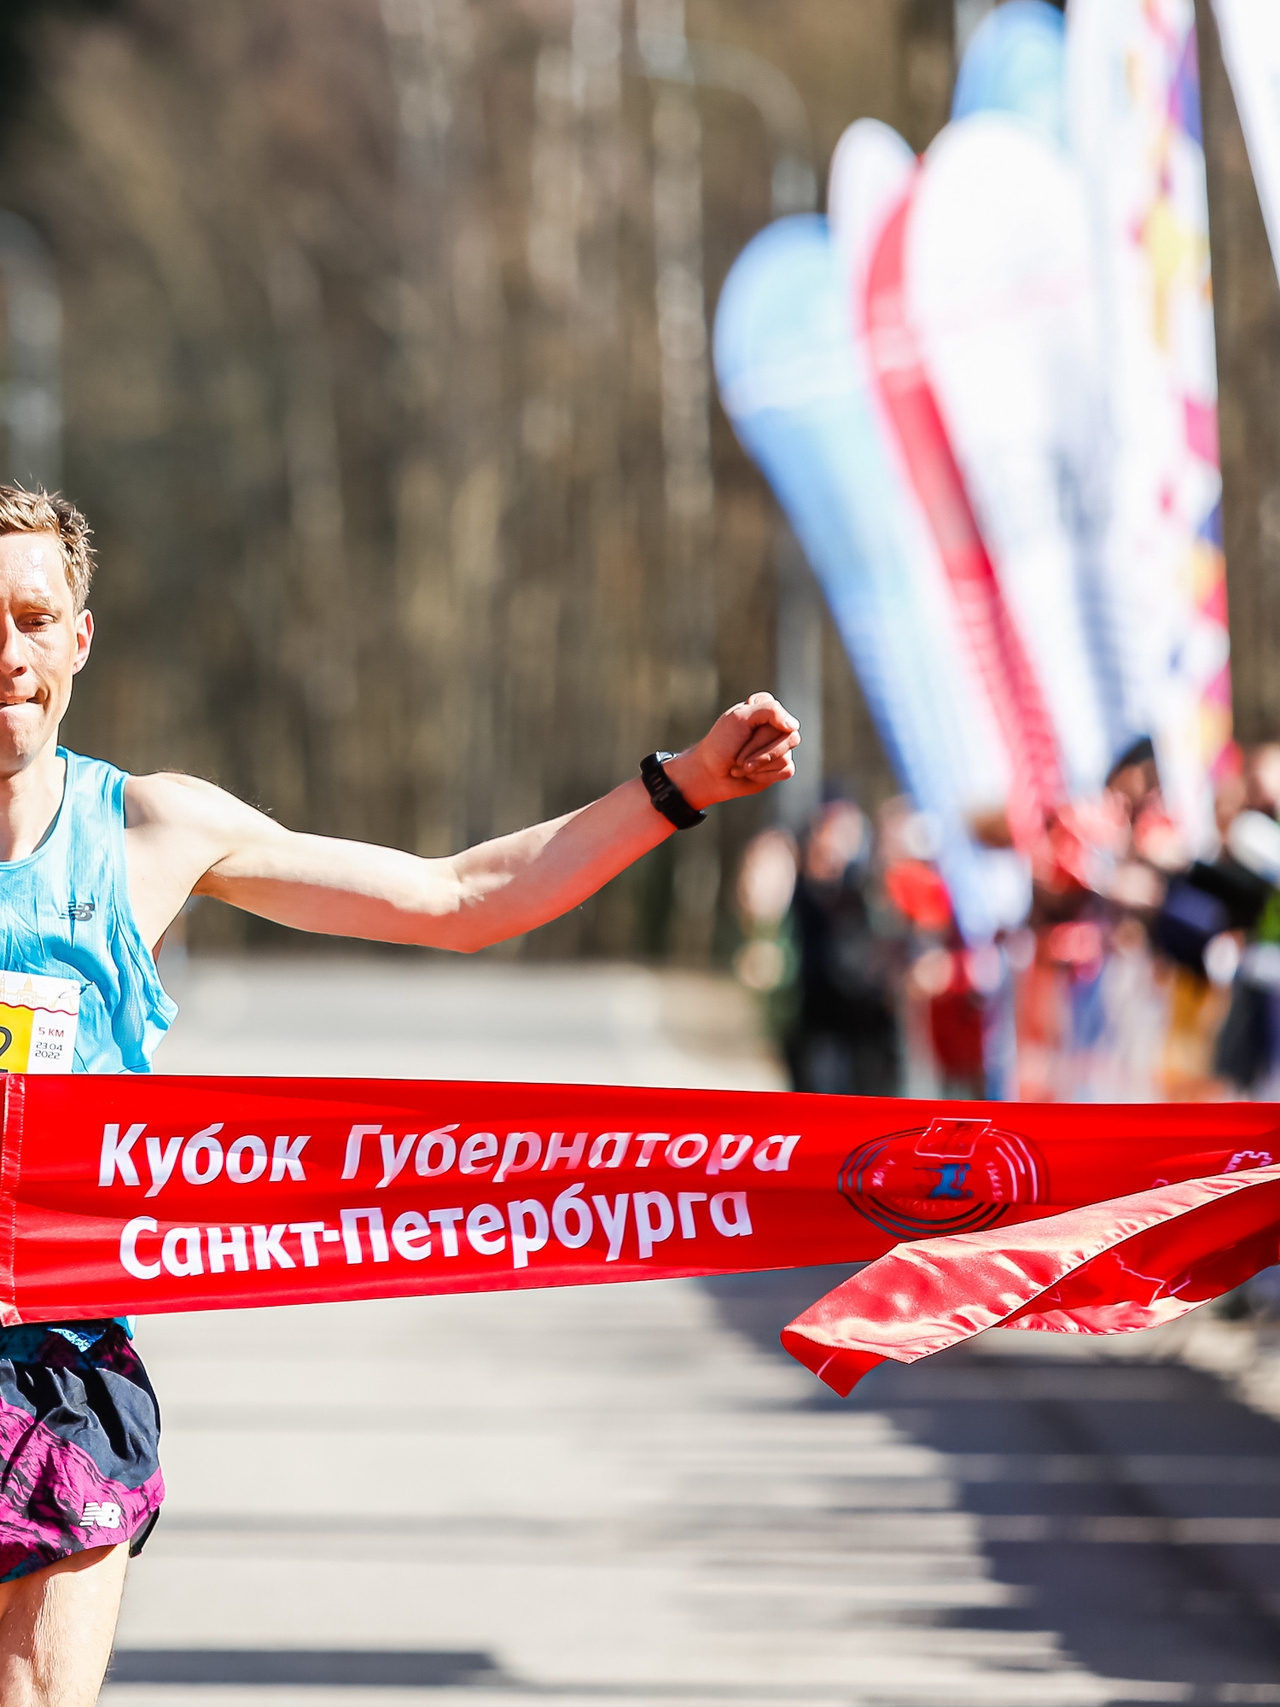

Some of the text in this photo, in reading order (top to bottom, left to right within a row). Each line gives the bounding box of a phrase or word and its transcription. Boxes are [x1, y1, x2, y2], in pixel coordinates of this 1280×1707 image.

[38, 1026, 46, 1036] 5
[35, 1049, 61, 1060] 2022
[97, 1122, 312, 1198] Кубок
[340, 1123, 802, 1189] Губернатора
[120, 1182, 754, 1280] Санкт-Петербурга
